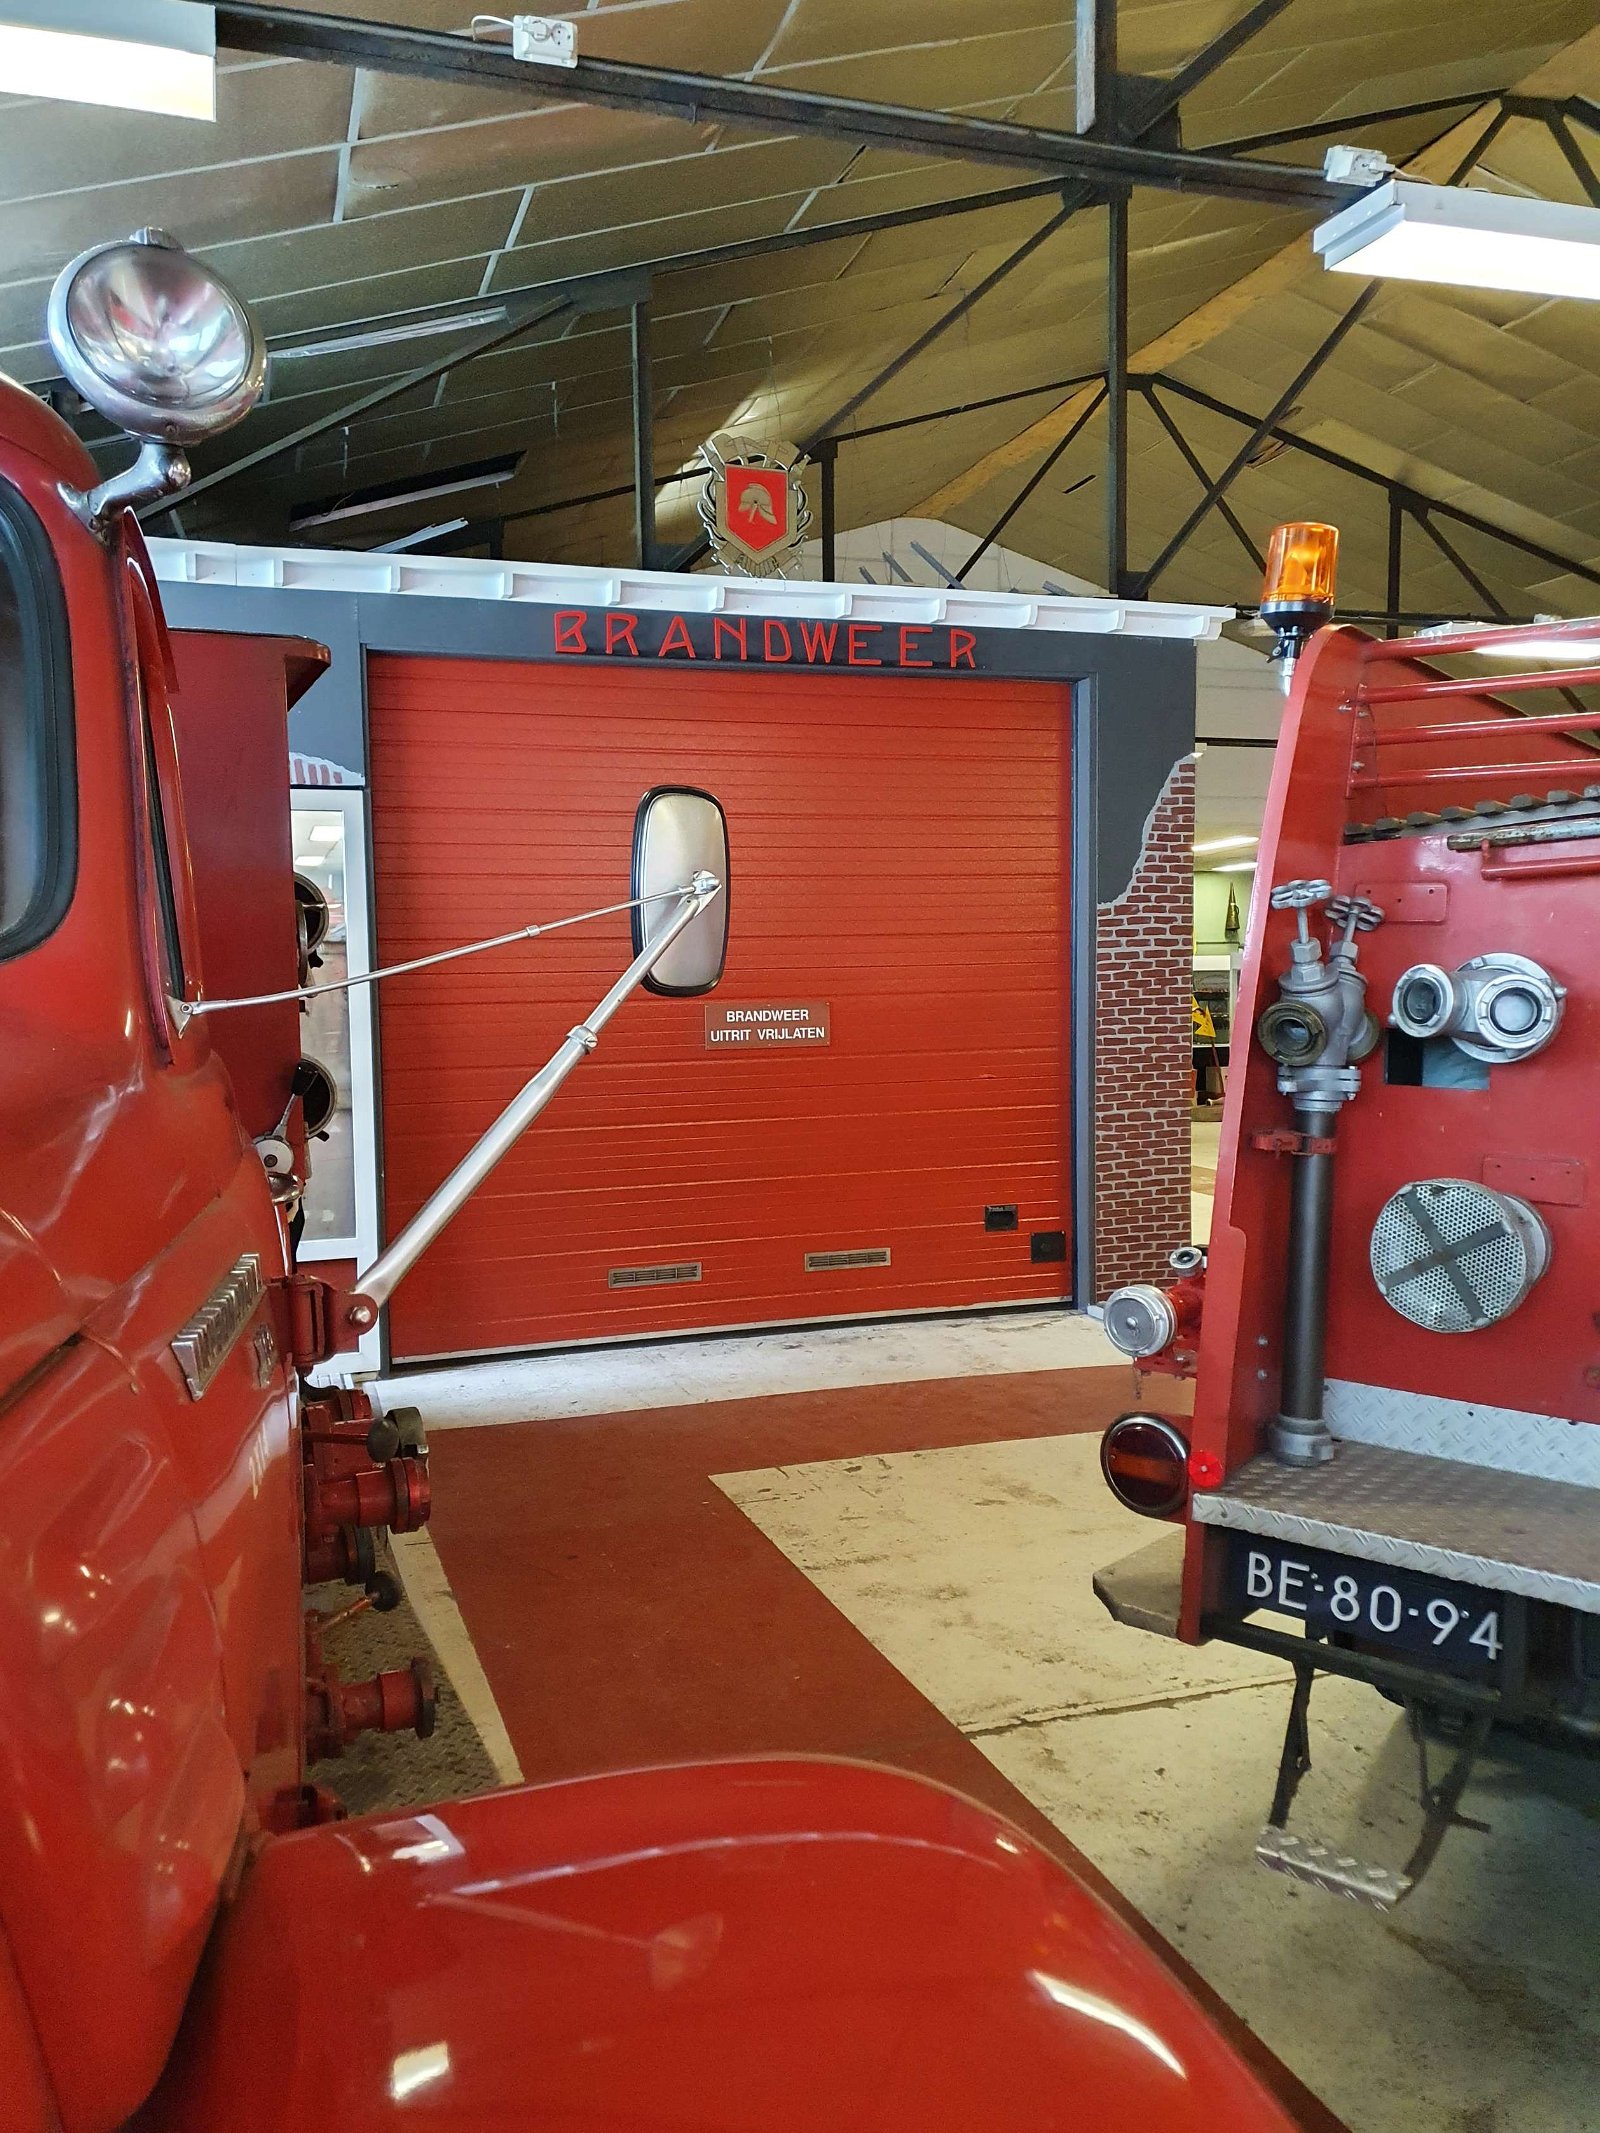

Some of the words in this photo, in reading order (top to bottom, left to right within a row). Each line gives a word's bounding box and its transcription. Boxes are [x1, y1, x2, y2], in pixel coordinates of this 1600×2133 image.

[553, 610, 977, 668] BRANDWEER
[710, 1029, 752, 1042] UITRIT
[757, 1026, 825, 1040] VRIJLATEN
[726, 1009, 809, 1022] BRANDWEER
[1247, 1550, 1503, 1660] BE-80-94
